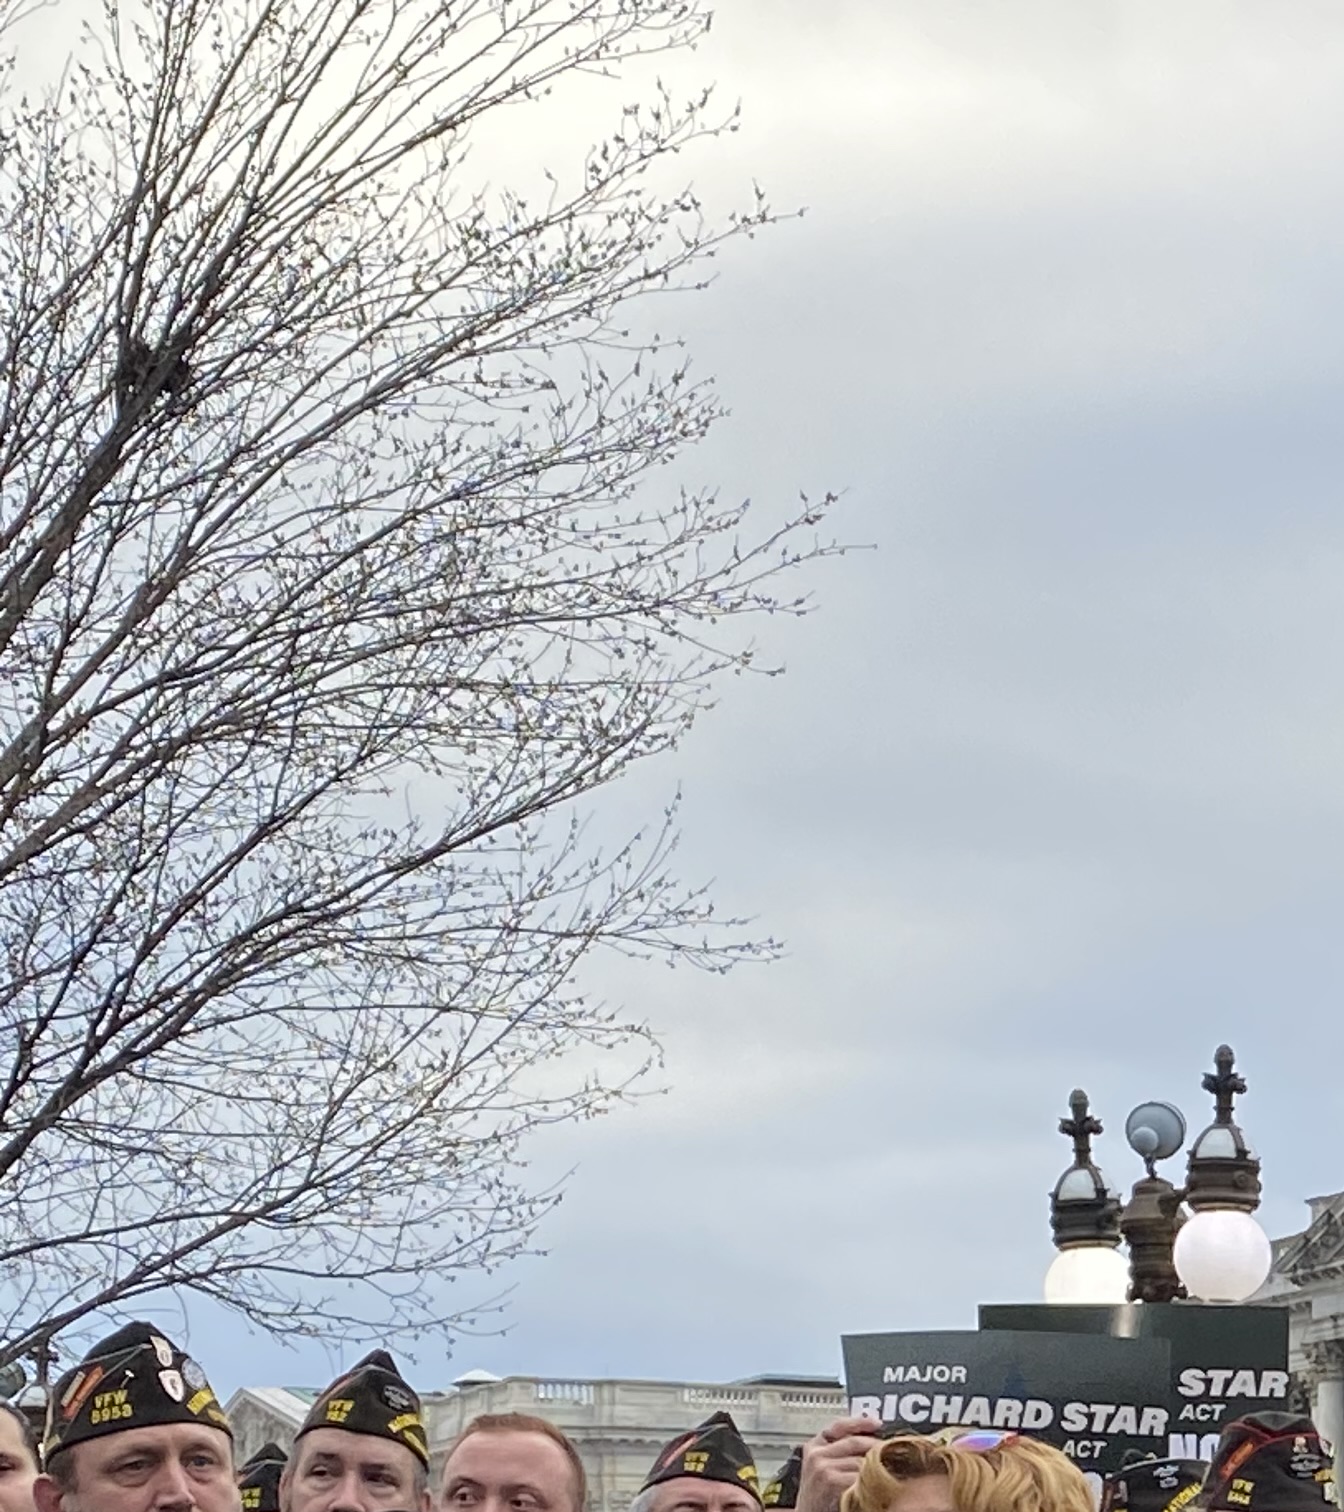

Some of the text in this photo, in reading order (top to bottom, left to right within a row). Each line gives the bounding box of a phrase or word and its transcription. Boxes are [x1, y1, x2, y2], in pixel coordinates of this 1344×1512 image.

[883, 1364, 968, 1384] MAJOR
[1177, 1367, 1290, 1398] STAR
[850, 1394, 1054, 1430] RICHARD
[1060, 1403, 1169, 1436] STAR
[1178, 1403, 1227, 1423] ACT
[1062, 1438, 1108, 1460] ACT
